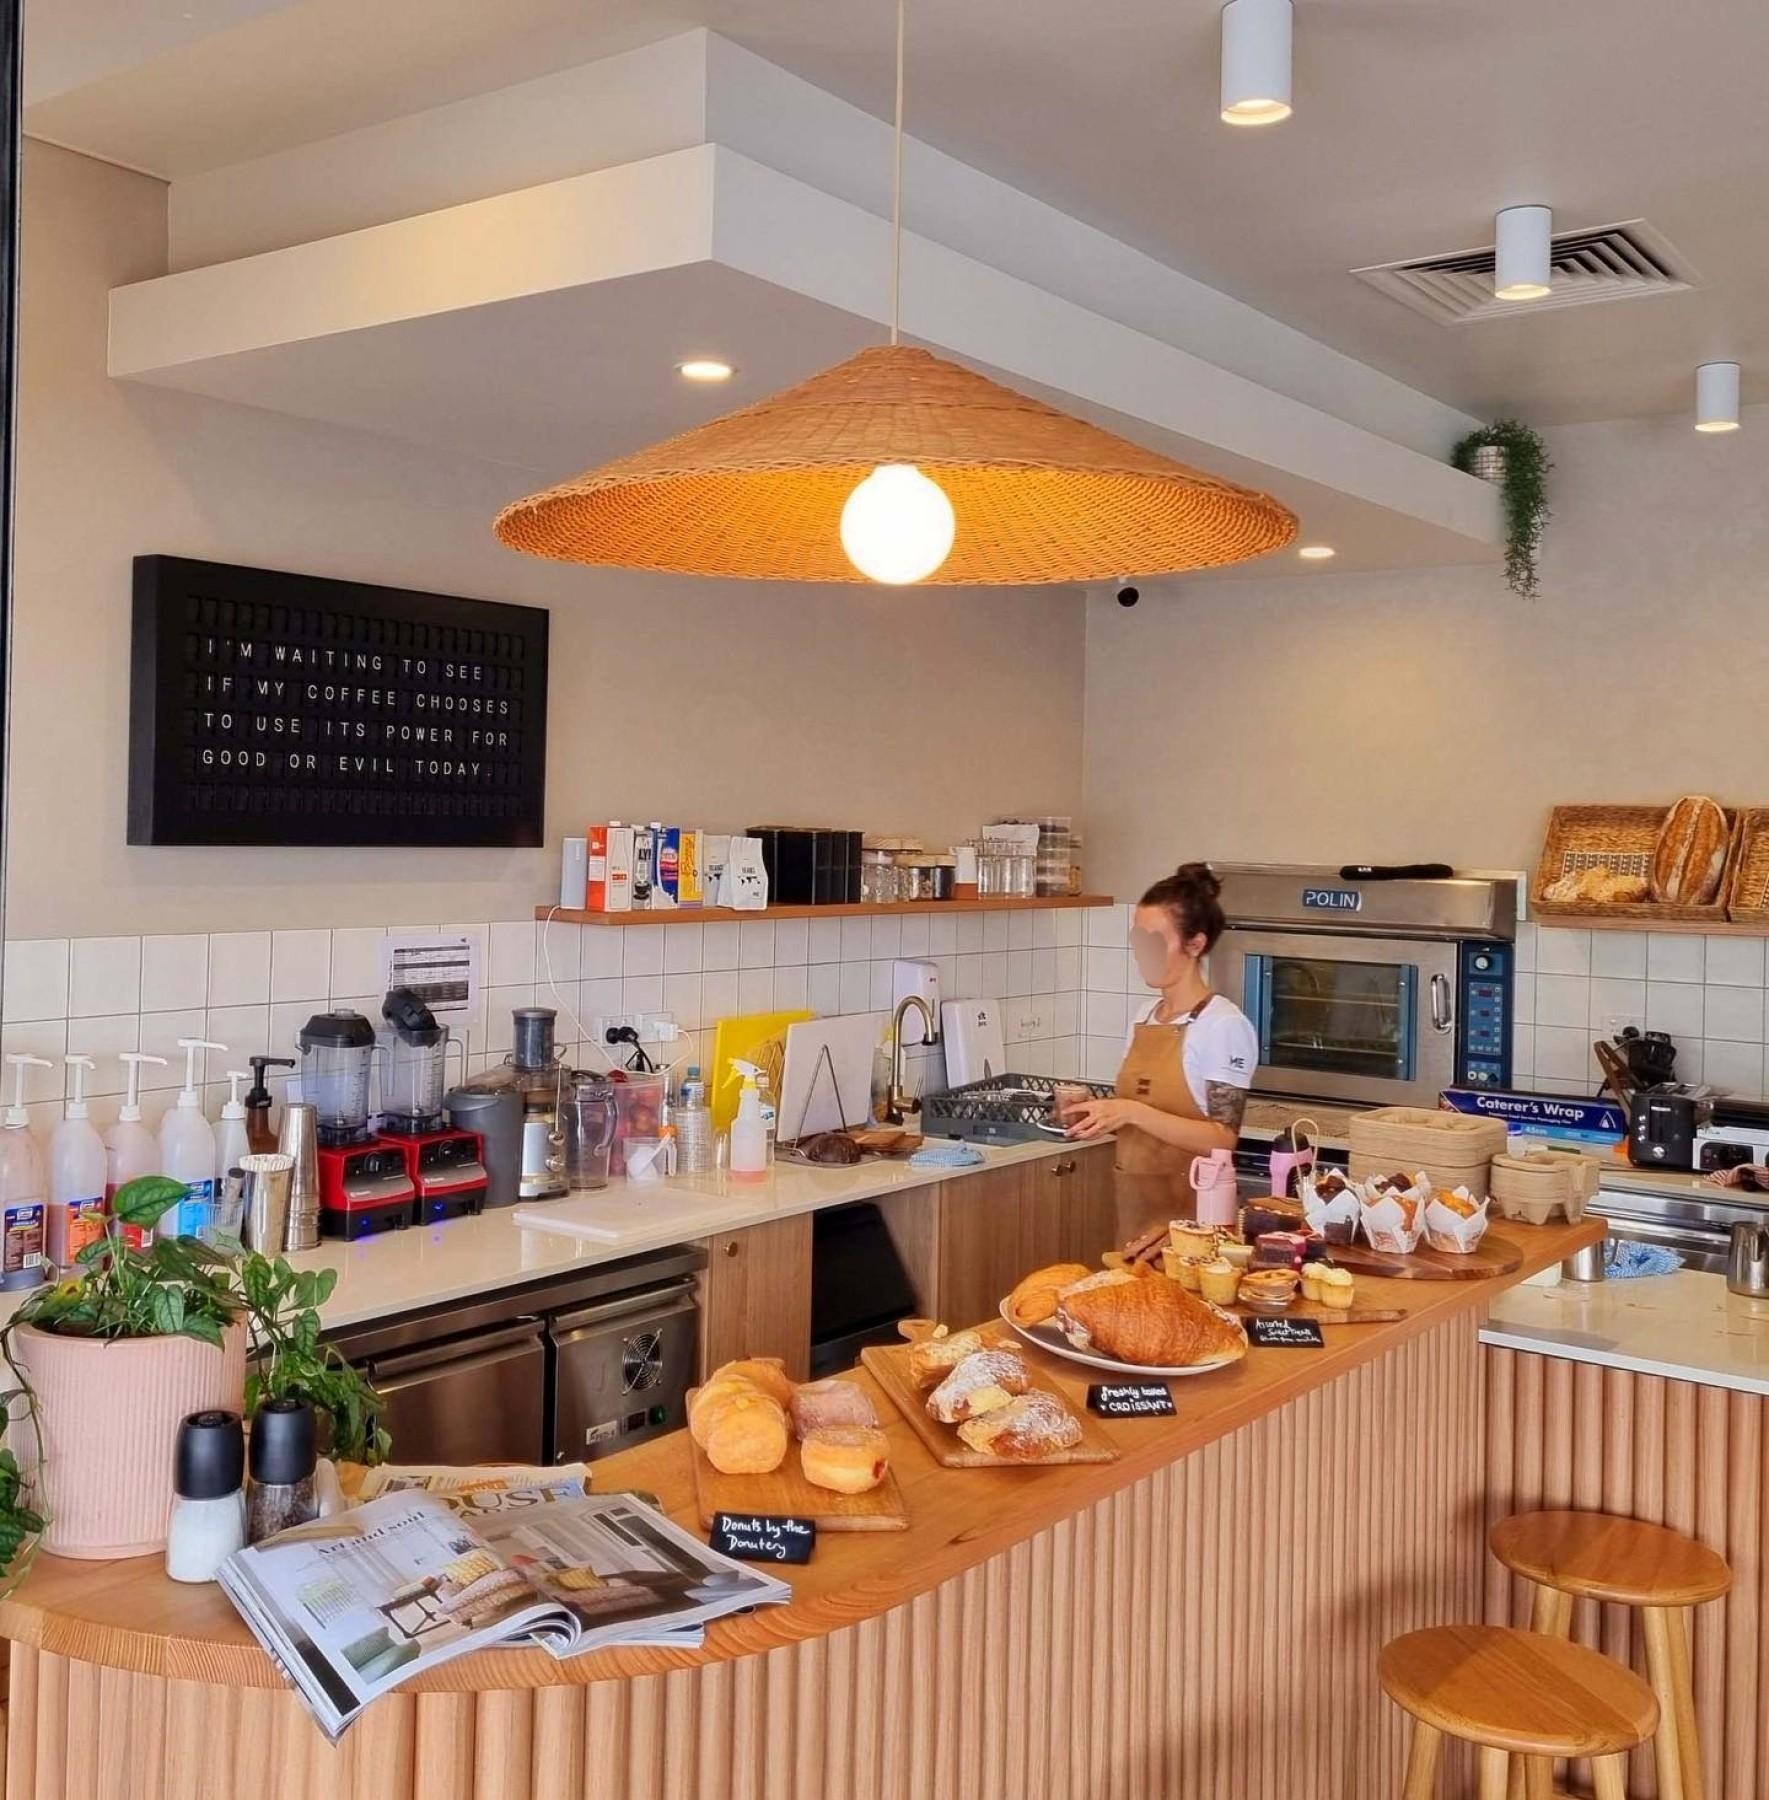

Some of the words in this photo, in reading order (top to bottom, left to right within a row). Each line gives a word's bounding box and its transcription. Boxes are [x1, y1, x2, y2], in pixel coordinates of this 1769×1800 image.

[207, 639, 253, 658] I'M
[274, 645, 383, 671] WAITING
[403, 659, 427, 674] TO
[445, 663, 482, 680] SEE
[207, 675, 232, 691] IF
[257, 680, 284, 696] MY
[306, 684, 396, 706] COFFEE
[416, 693, 508, 715] CHOOSES
[203, 713, 233, 729] TO
[255, 716, 301, 733] USE
[326, 721, 365, 737] ITS
[385, 725, 453, 743] POWER
[471, 730, 507, 746] FOR
[202, 749, 266, 767] GOOD
[289, 753, 316, 769] OR
[338, 756, 394, 773] EVIL
[415, 760, 492, 777] TODAY.
[1305, 890, 1356, 908] POLIN
[1476, 1096, 1540, 1114] Caterer's
[1543, 1103, 1585, 1121] Wrap
[721, 1516, 762, 1533] Donuts
[765, 1519, 781, 1538] by
[782, 1519, 811, 1534] the
[317, 1540, 347, 1556] Art
[725, 1534, 786, 1559] Donutery
